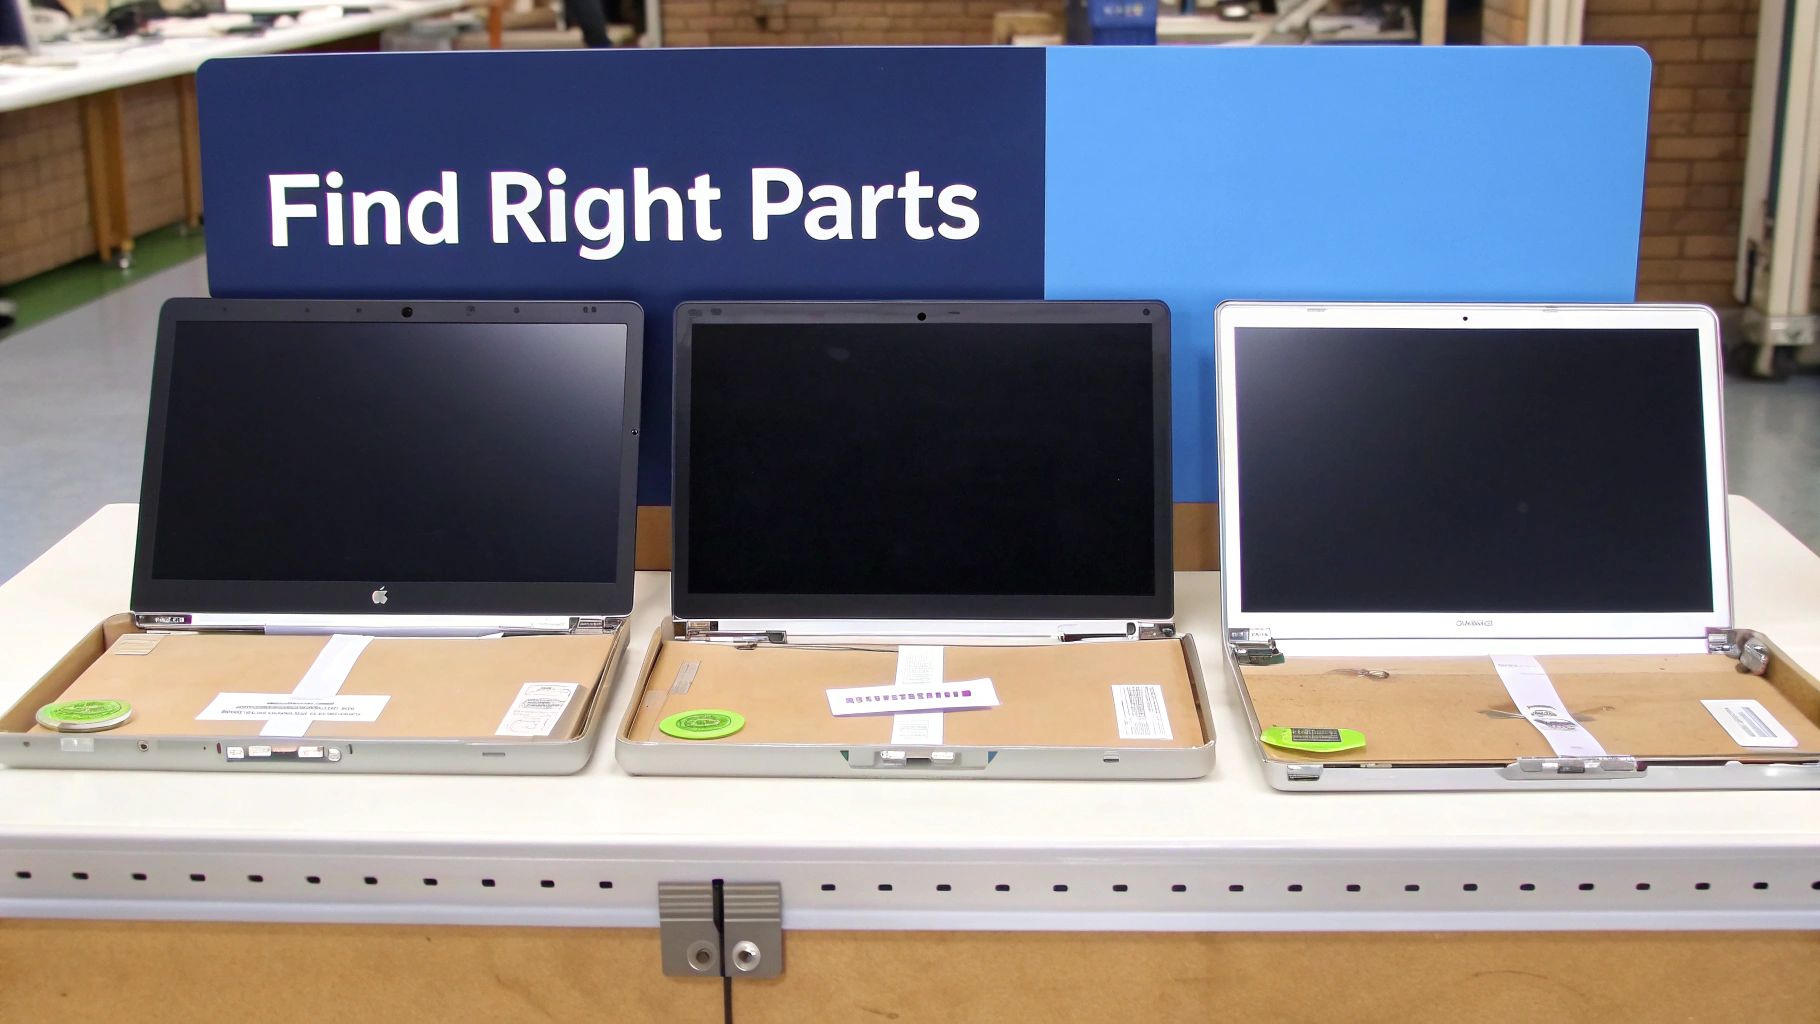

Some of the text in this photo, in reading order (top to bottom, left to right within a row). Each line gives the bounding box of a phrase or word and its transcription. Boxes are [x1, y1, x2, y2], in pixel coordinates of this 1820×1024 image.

[269, 167, 980, 261] Find Right Parts
